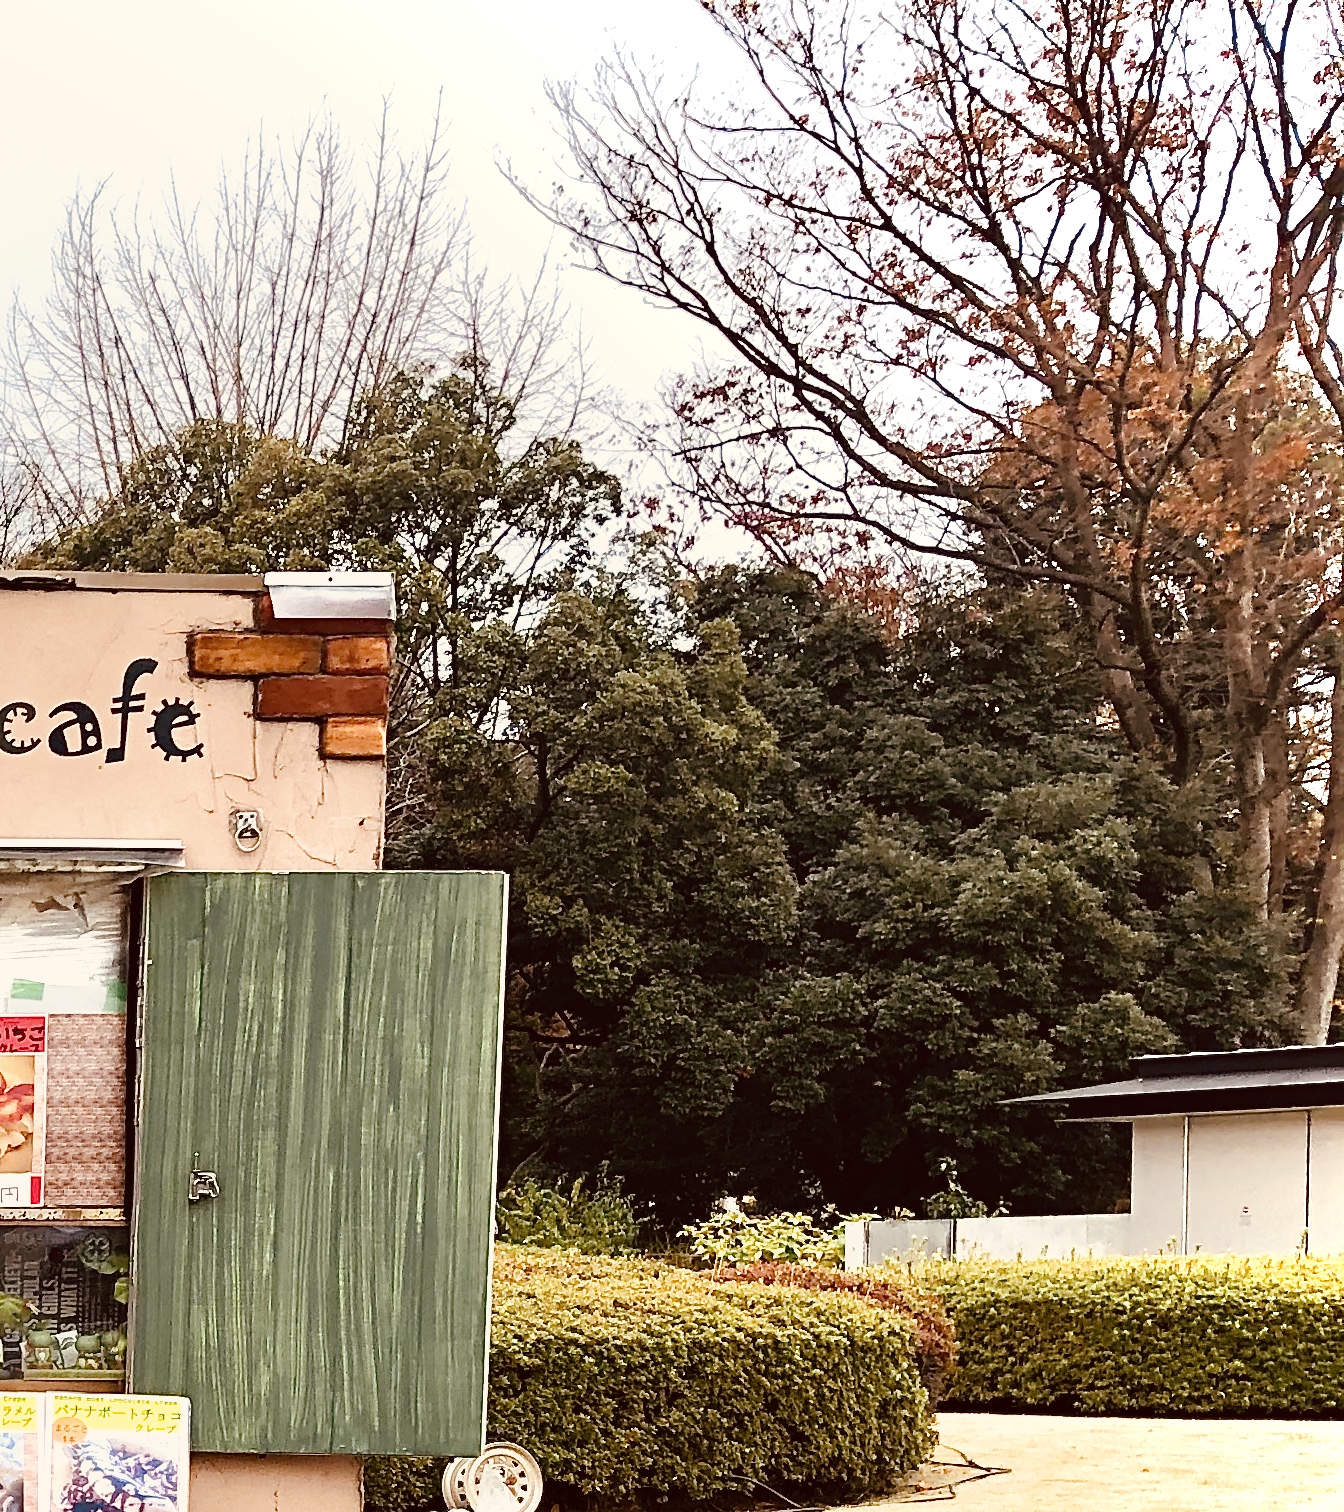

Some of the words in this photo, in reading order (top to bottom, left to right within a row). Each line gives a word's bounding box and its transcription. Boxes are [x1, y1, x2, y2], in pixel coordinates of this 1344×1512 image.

[54, 1406, 182, 1421] バナナボートチョコ
[135, 1424, 177, 1434] クレープ
